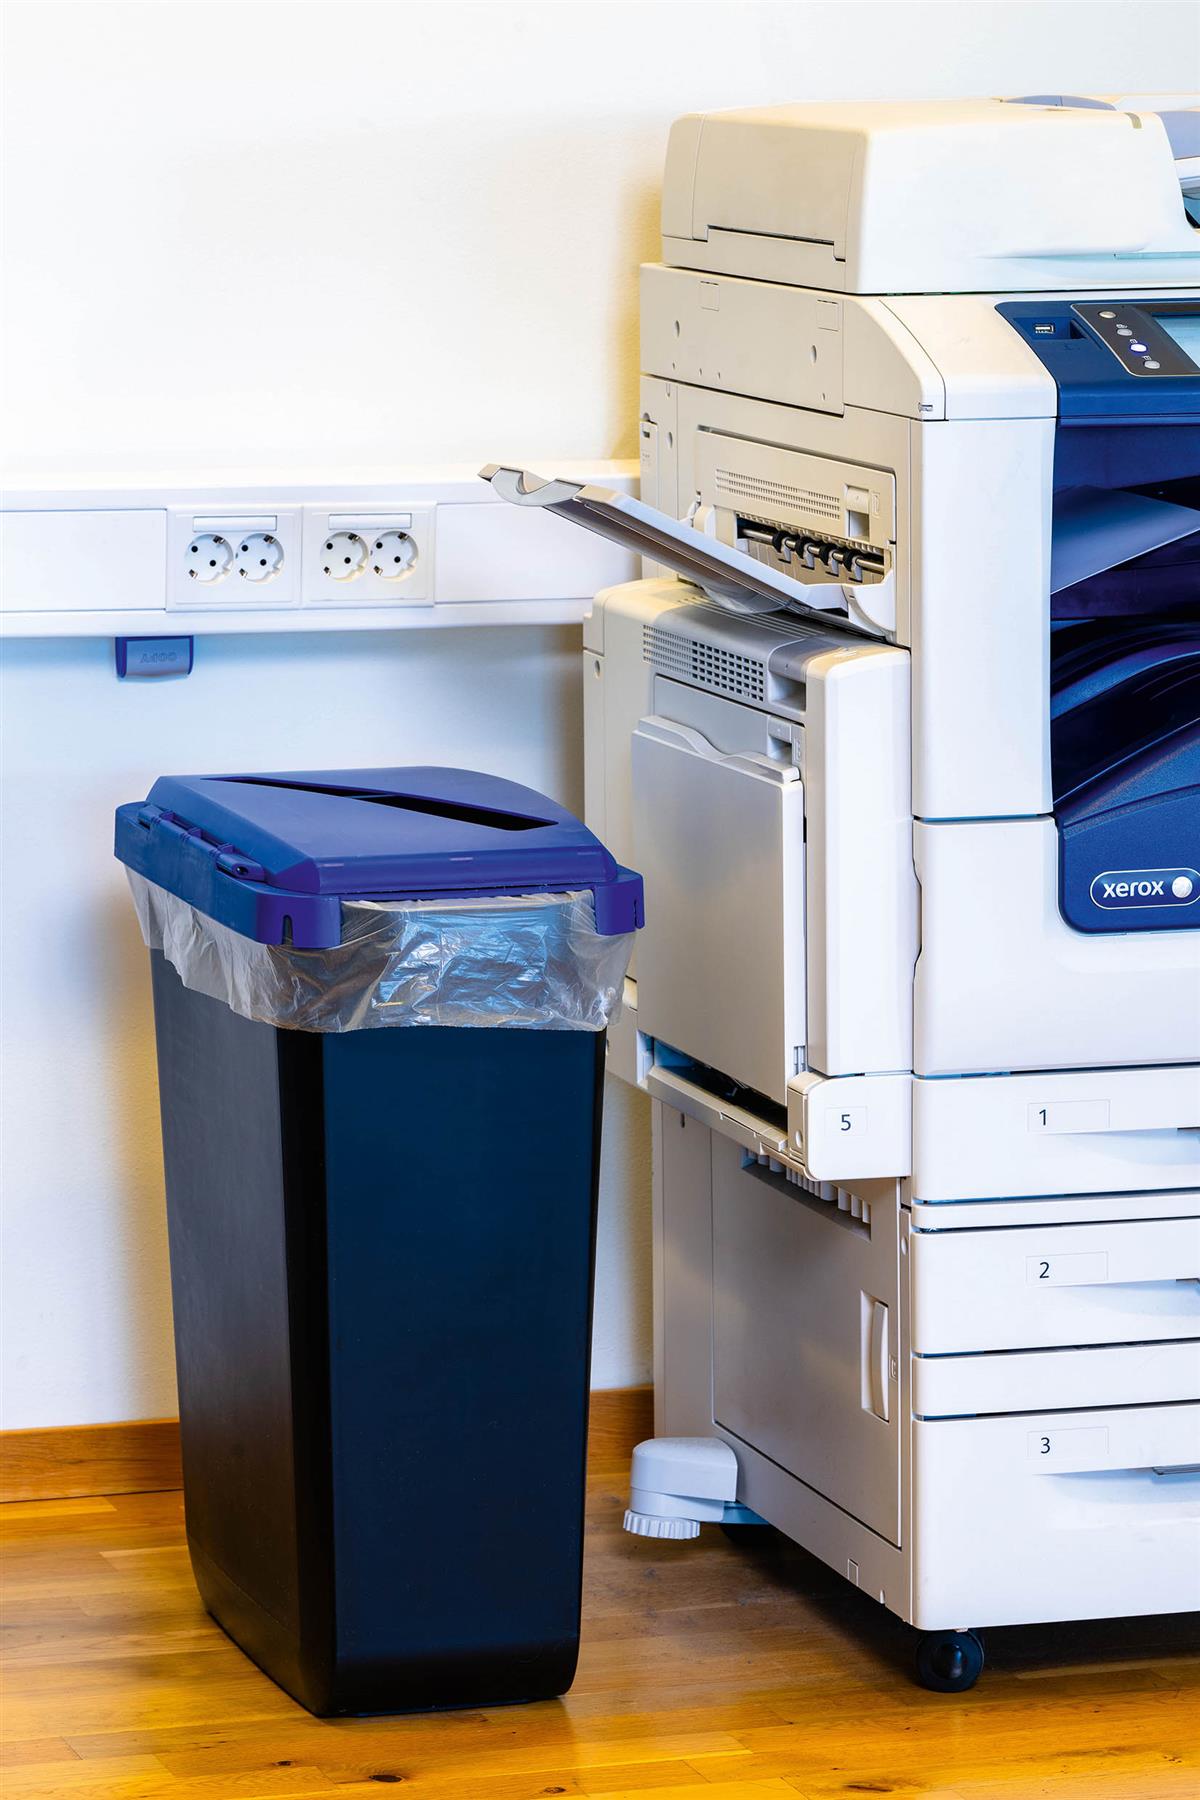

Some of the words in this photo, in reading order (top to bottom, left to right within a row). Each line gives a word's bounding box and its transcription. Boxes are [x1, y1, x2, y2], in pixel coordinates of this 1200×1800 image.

[1103, 880, 1164, 898] xerox
[840, 1113, 852, 1132] 5
[1038, 1108, 1047, 1126] 1
[1039, 1261, 1050, 1279] 2
[1040, 1436, 1051, 1455] 3
